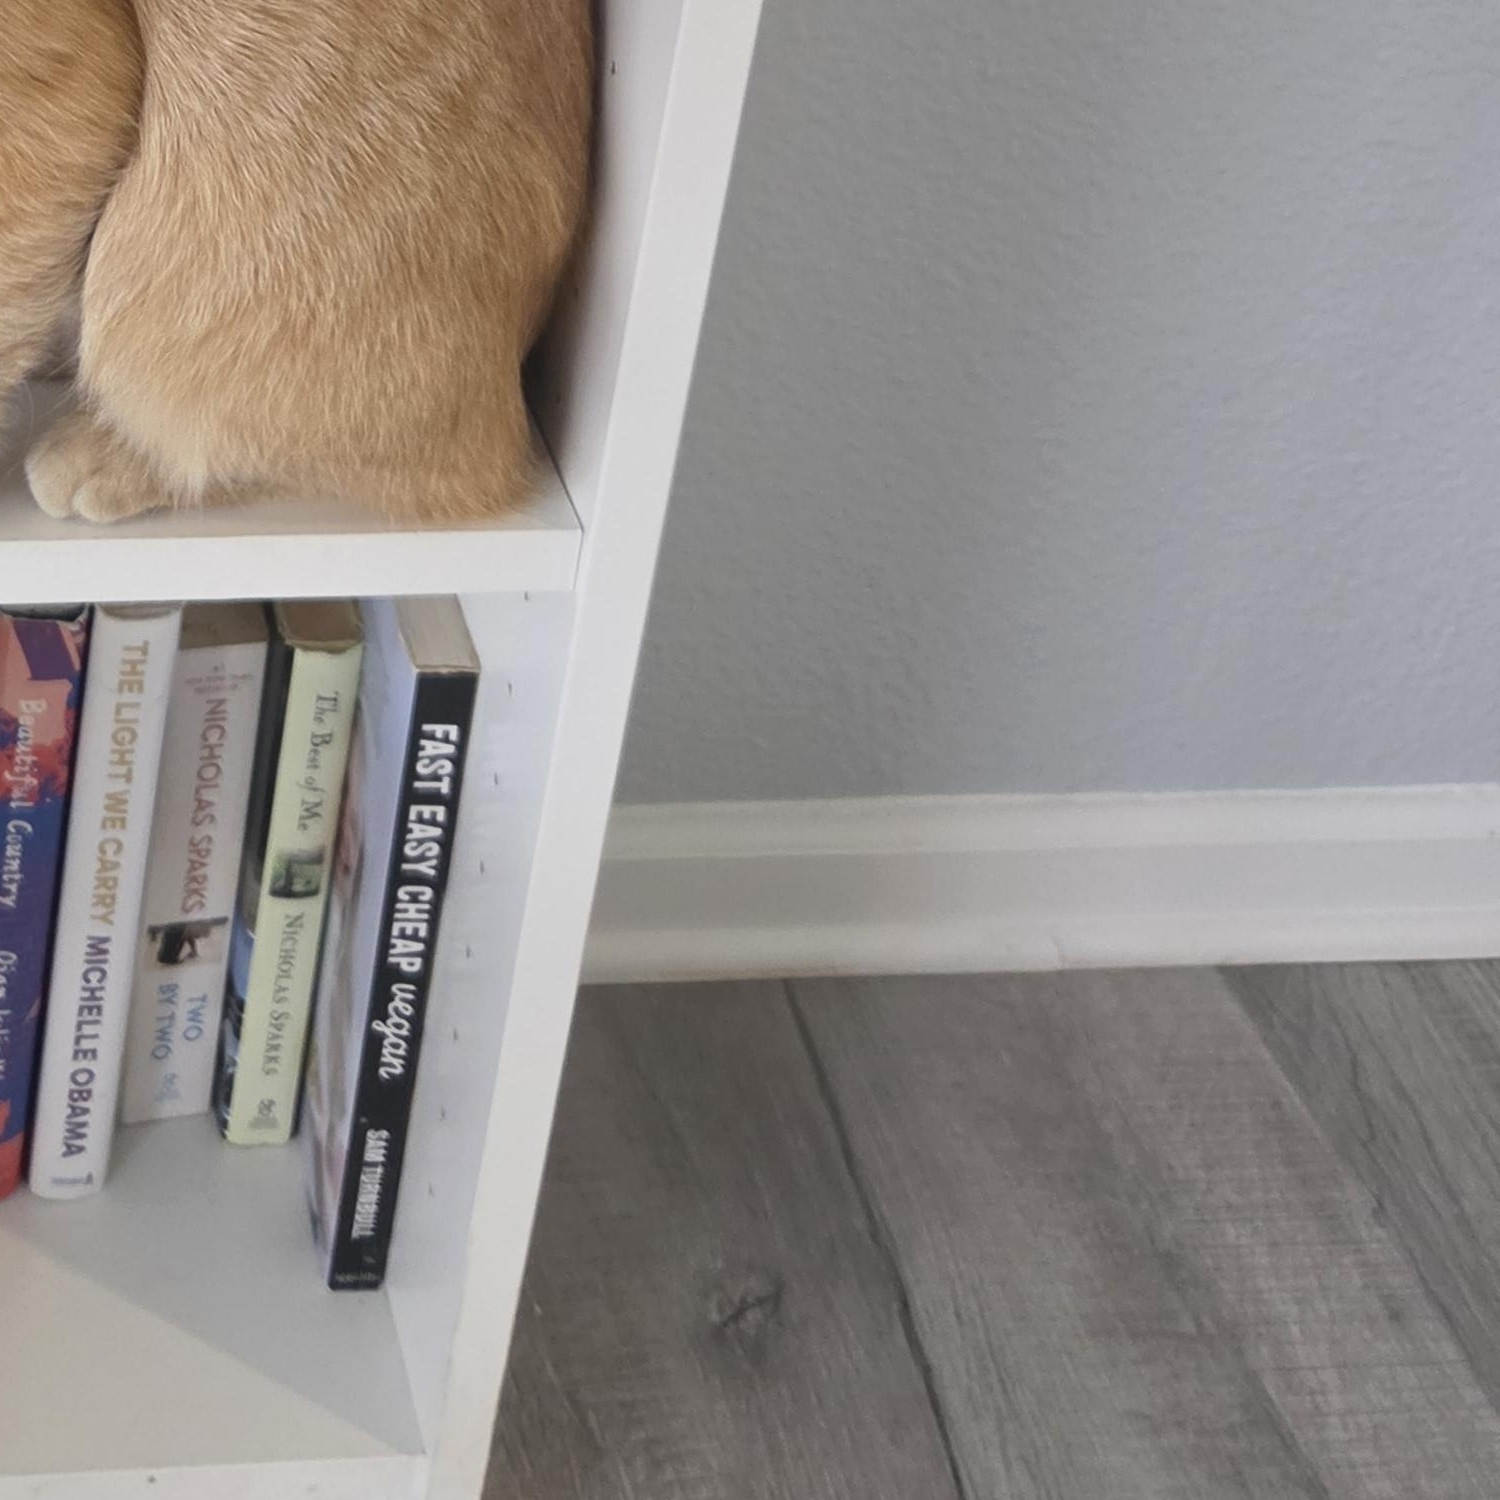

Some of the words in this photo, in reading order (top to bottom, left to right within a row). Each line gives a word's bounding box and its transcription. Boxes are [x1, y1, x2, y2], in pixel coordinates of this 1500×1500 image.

[117, 640, 150, 695] THE
[108, 701, 142, 784] LIGHT
[315, 691, 339, 726] The
[4, 699, 48, 809] Beautiful
[190, 697, 228, 828] NICHOLAS
[306, 731, 333, 771] Best
[412, 723, 460, 795] FAST
[101, 790, 130, 831] WE
[297, 797, 323, 831] Me
[401, 804, 447, 876] EASY
[90, 838, 124, 926] CARRY
[181, 834, 213, 914] SPARKS
[267, 912, 305, 1007] NICHOLAS
[387, 884, 434, 975] CHEAP
[72, 935, 112, 1062] MICHELLE
[158, 983, 179, 1012] BY
[183, 993, 208, 1042] TWO
[372, 983, 418, 1079] vegan
[151, 1012, 176, 1060] TWO
[260, 1009, 290, 1078] SPARKS
[61, 1068, 95, 1158] OBAMA
